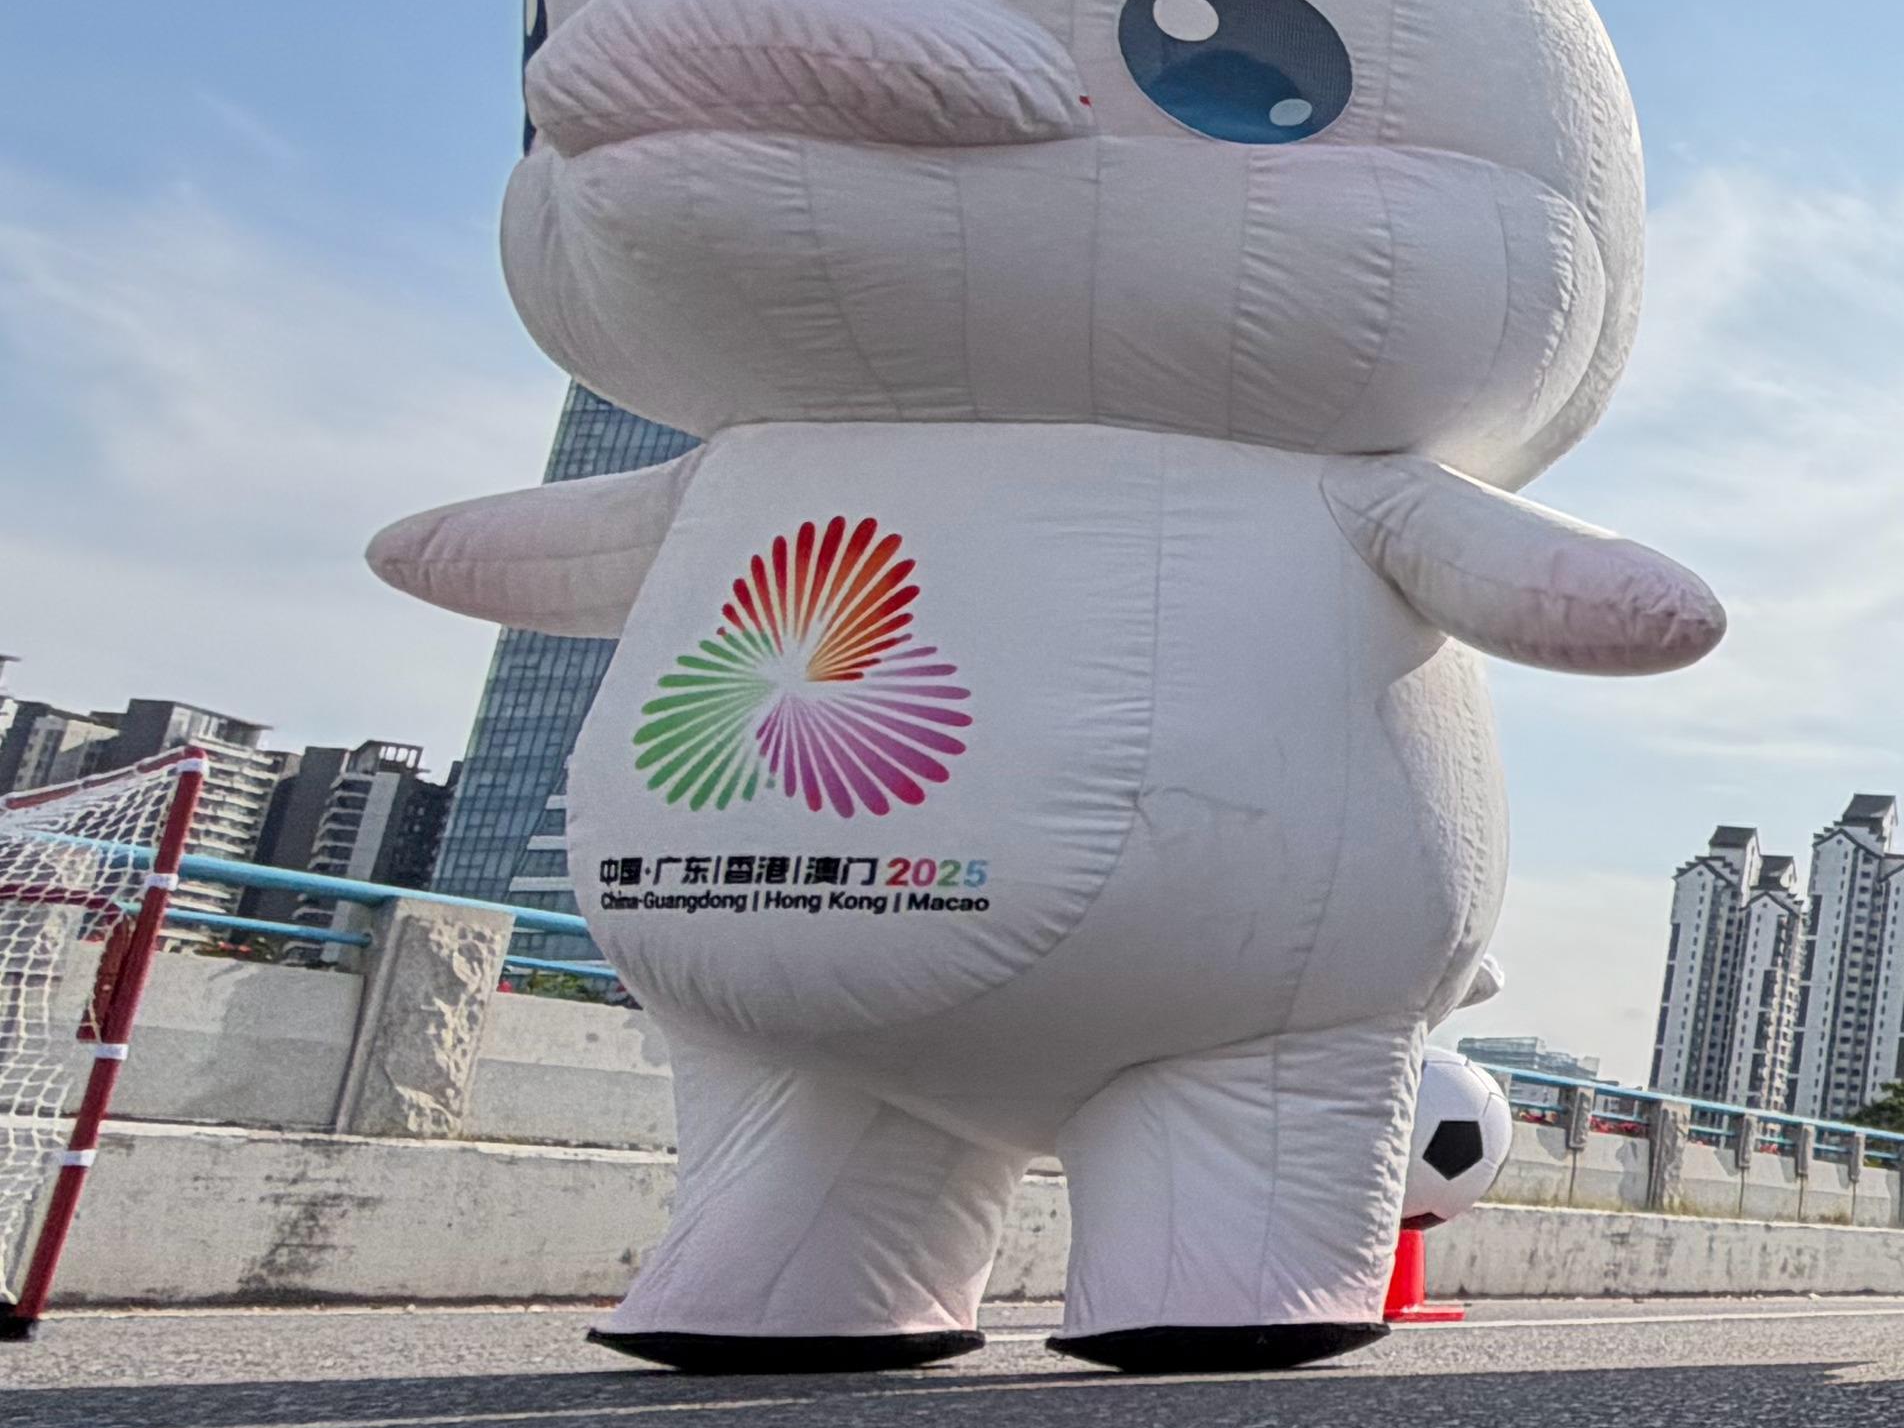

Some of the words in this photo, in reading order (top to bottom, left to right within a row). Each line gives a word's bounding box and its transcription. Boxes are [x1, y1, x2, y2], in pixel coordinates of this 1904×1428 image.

[885, 857, 989, 887] 2025
[764, 890, 822, 914] Hong
[828, 891, 888, 915] Kong
[907, 892, 990, 912] Macao
